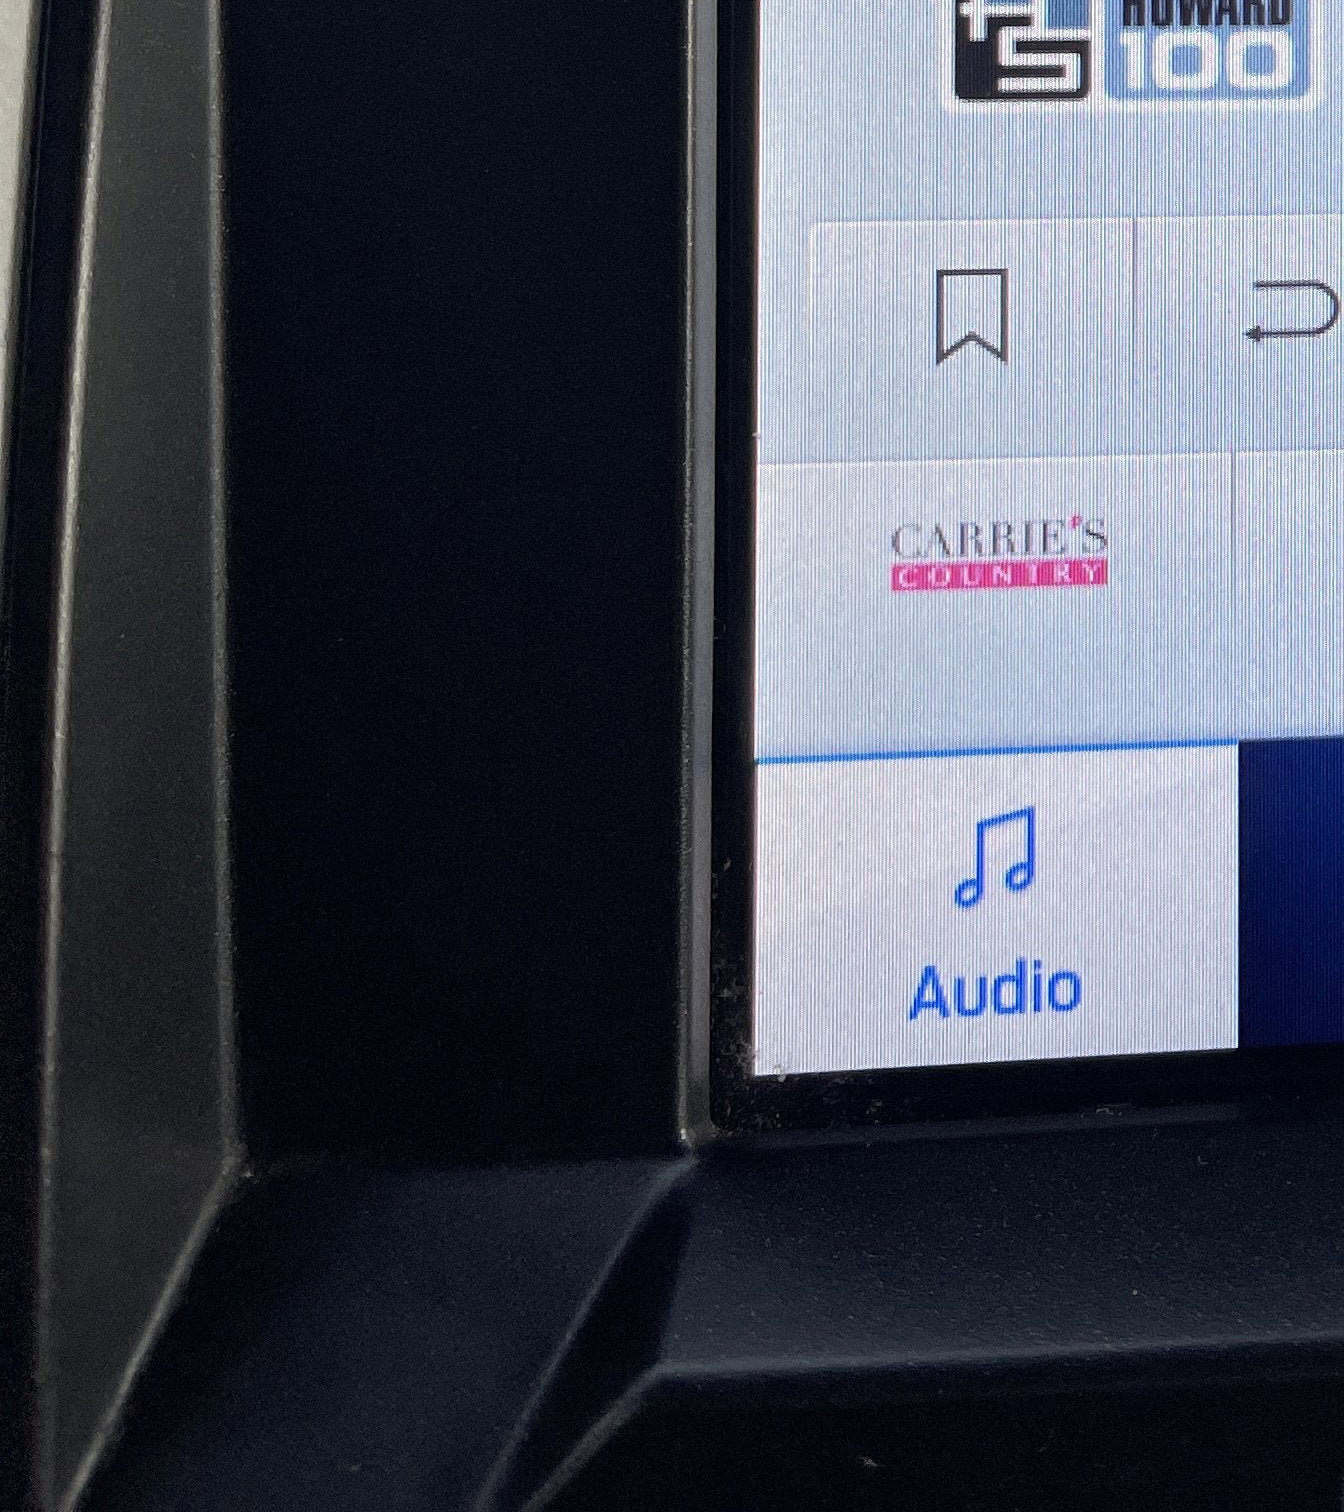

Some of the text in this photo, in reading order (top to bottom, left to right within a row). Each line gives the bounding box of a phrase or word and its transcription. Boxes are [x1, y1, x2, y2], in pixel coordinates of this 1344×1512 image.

[1119, 29, 1295, 92] 100
[891, 513, 1108, 558] CARRIE'S
[908, 959, 1083, 1021] Audio
